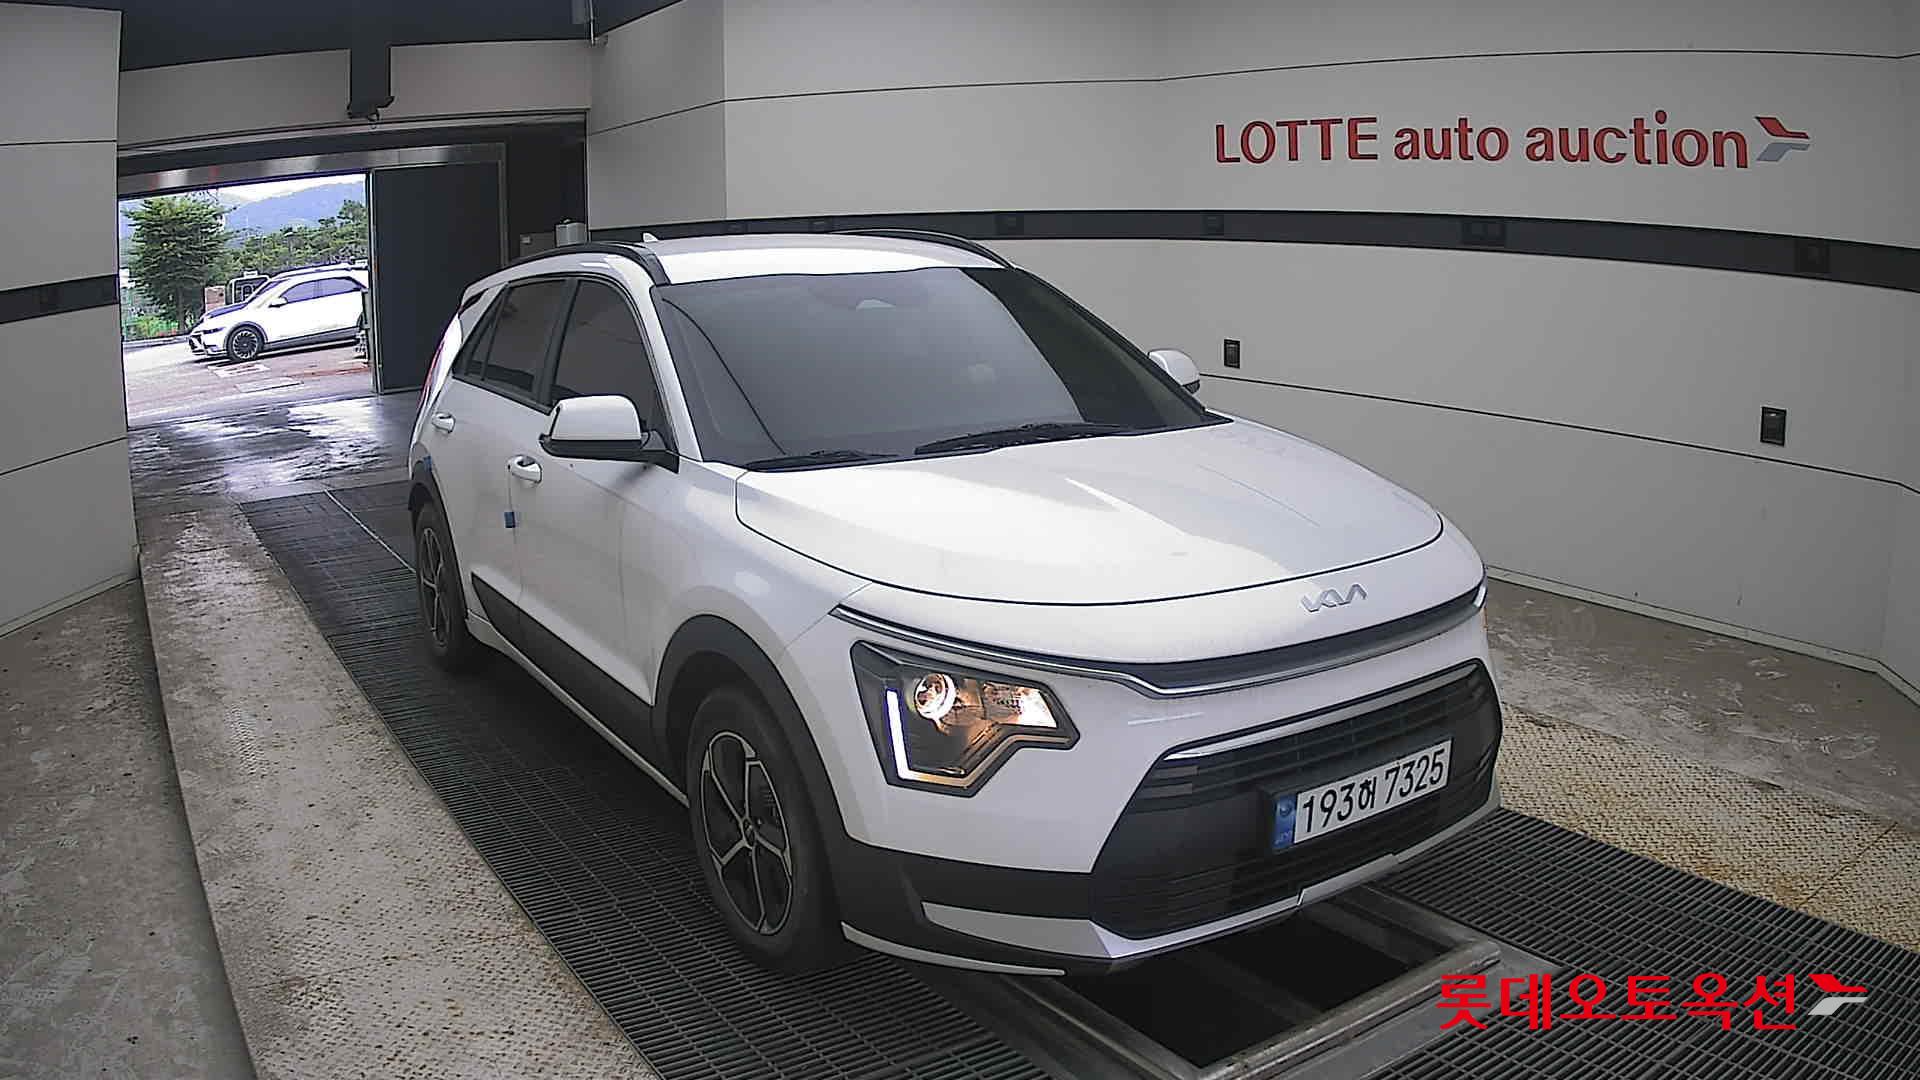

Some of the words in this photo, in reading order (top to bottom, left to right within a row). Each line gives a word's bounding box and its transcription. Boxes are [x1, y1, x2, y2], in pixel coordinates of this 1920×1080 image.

[1215, 116, 1378, 166] LOTTE
[1394, 117, 1510, 163] auto
[1525, 110, 1749, 169] auction
[1302, 776, 1378, 833] 193허
[1384, 748, 1446, 804] 7325
